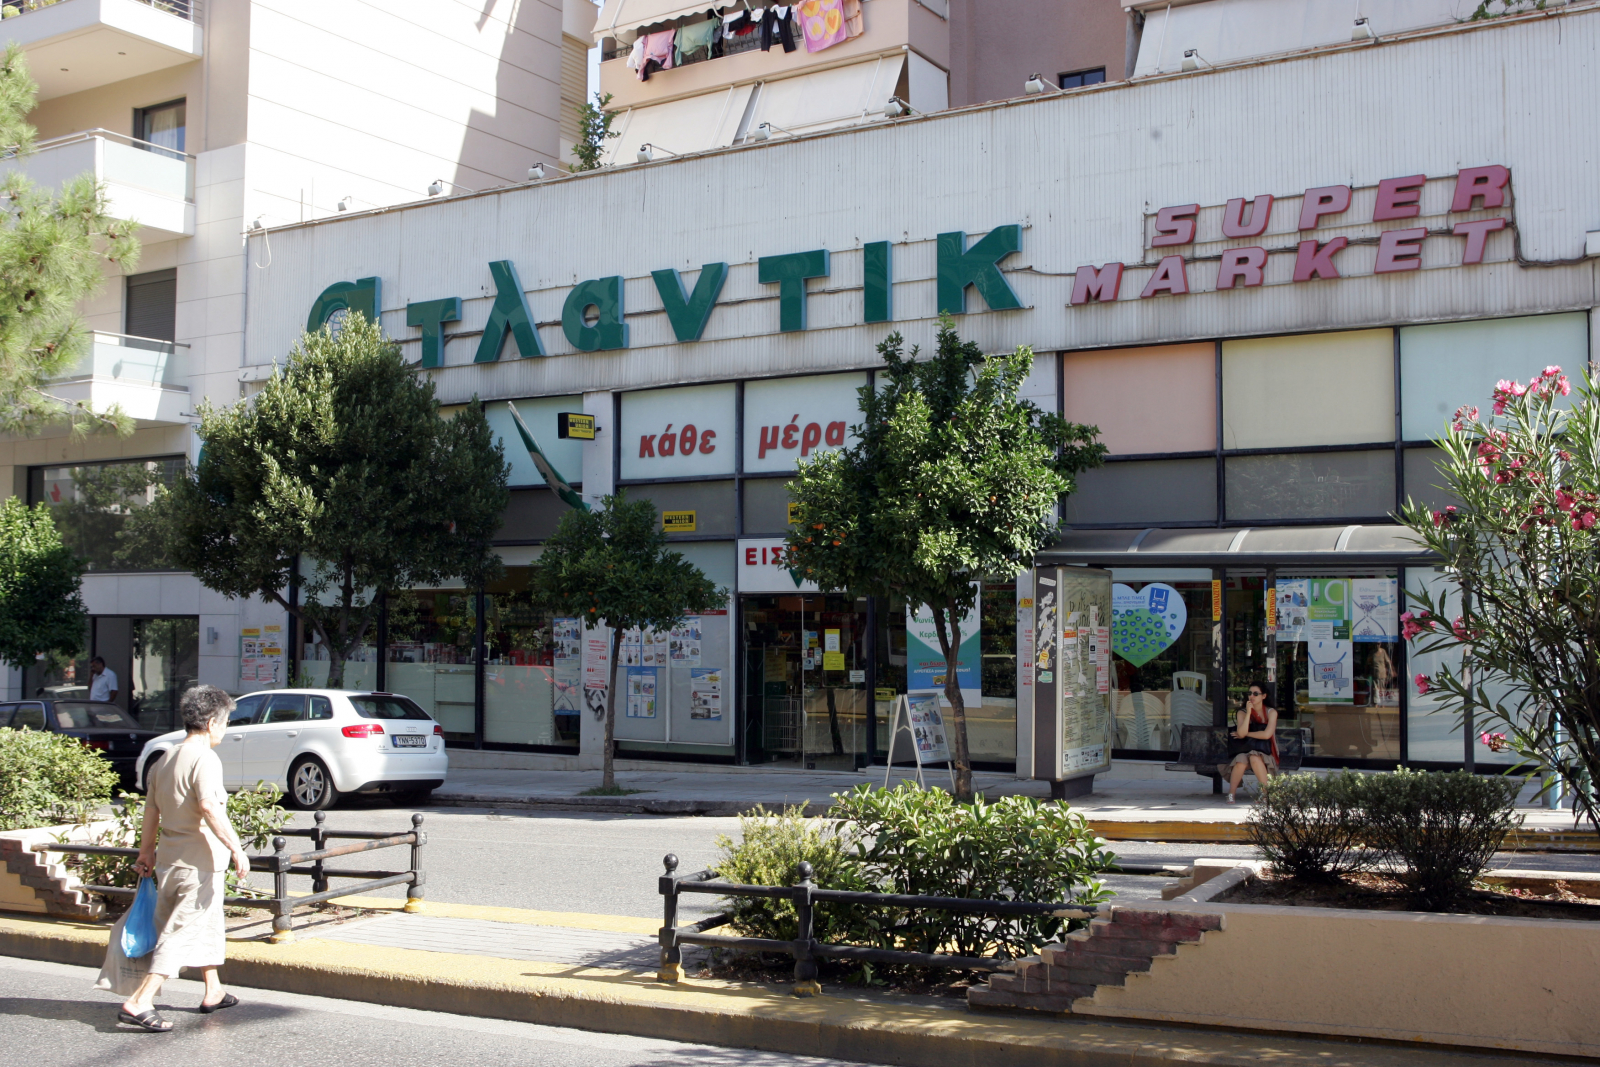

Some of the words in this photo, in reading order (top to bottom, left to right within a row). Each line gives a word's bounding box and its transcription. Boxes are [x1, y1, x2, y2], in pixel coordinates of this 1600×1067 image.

[1151, 164, 1511, 248] SUPER
[1070, 217, 1507, 306] MARKET
[638, 423, 717, 459] κάθε
[758, 413, 847, 460] μέρα
